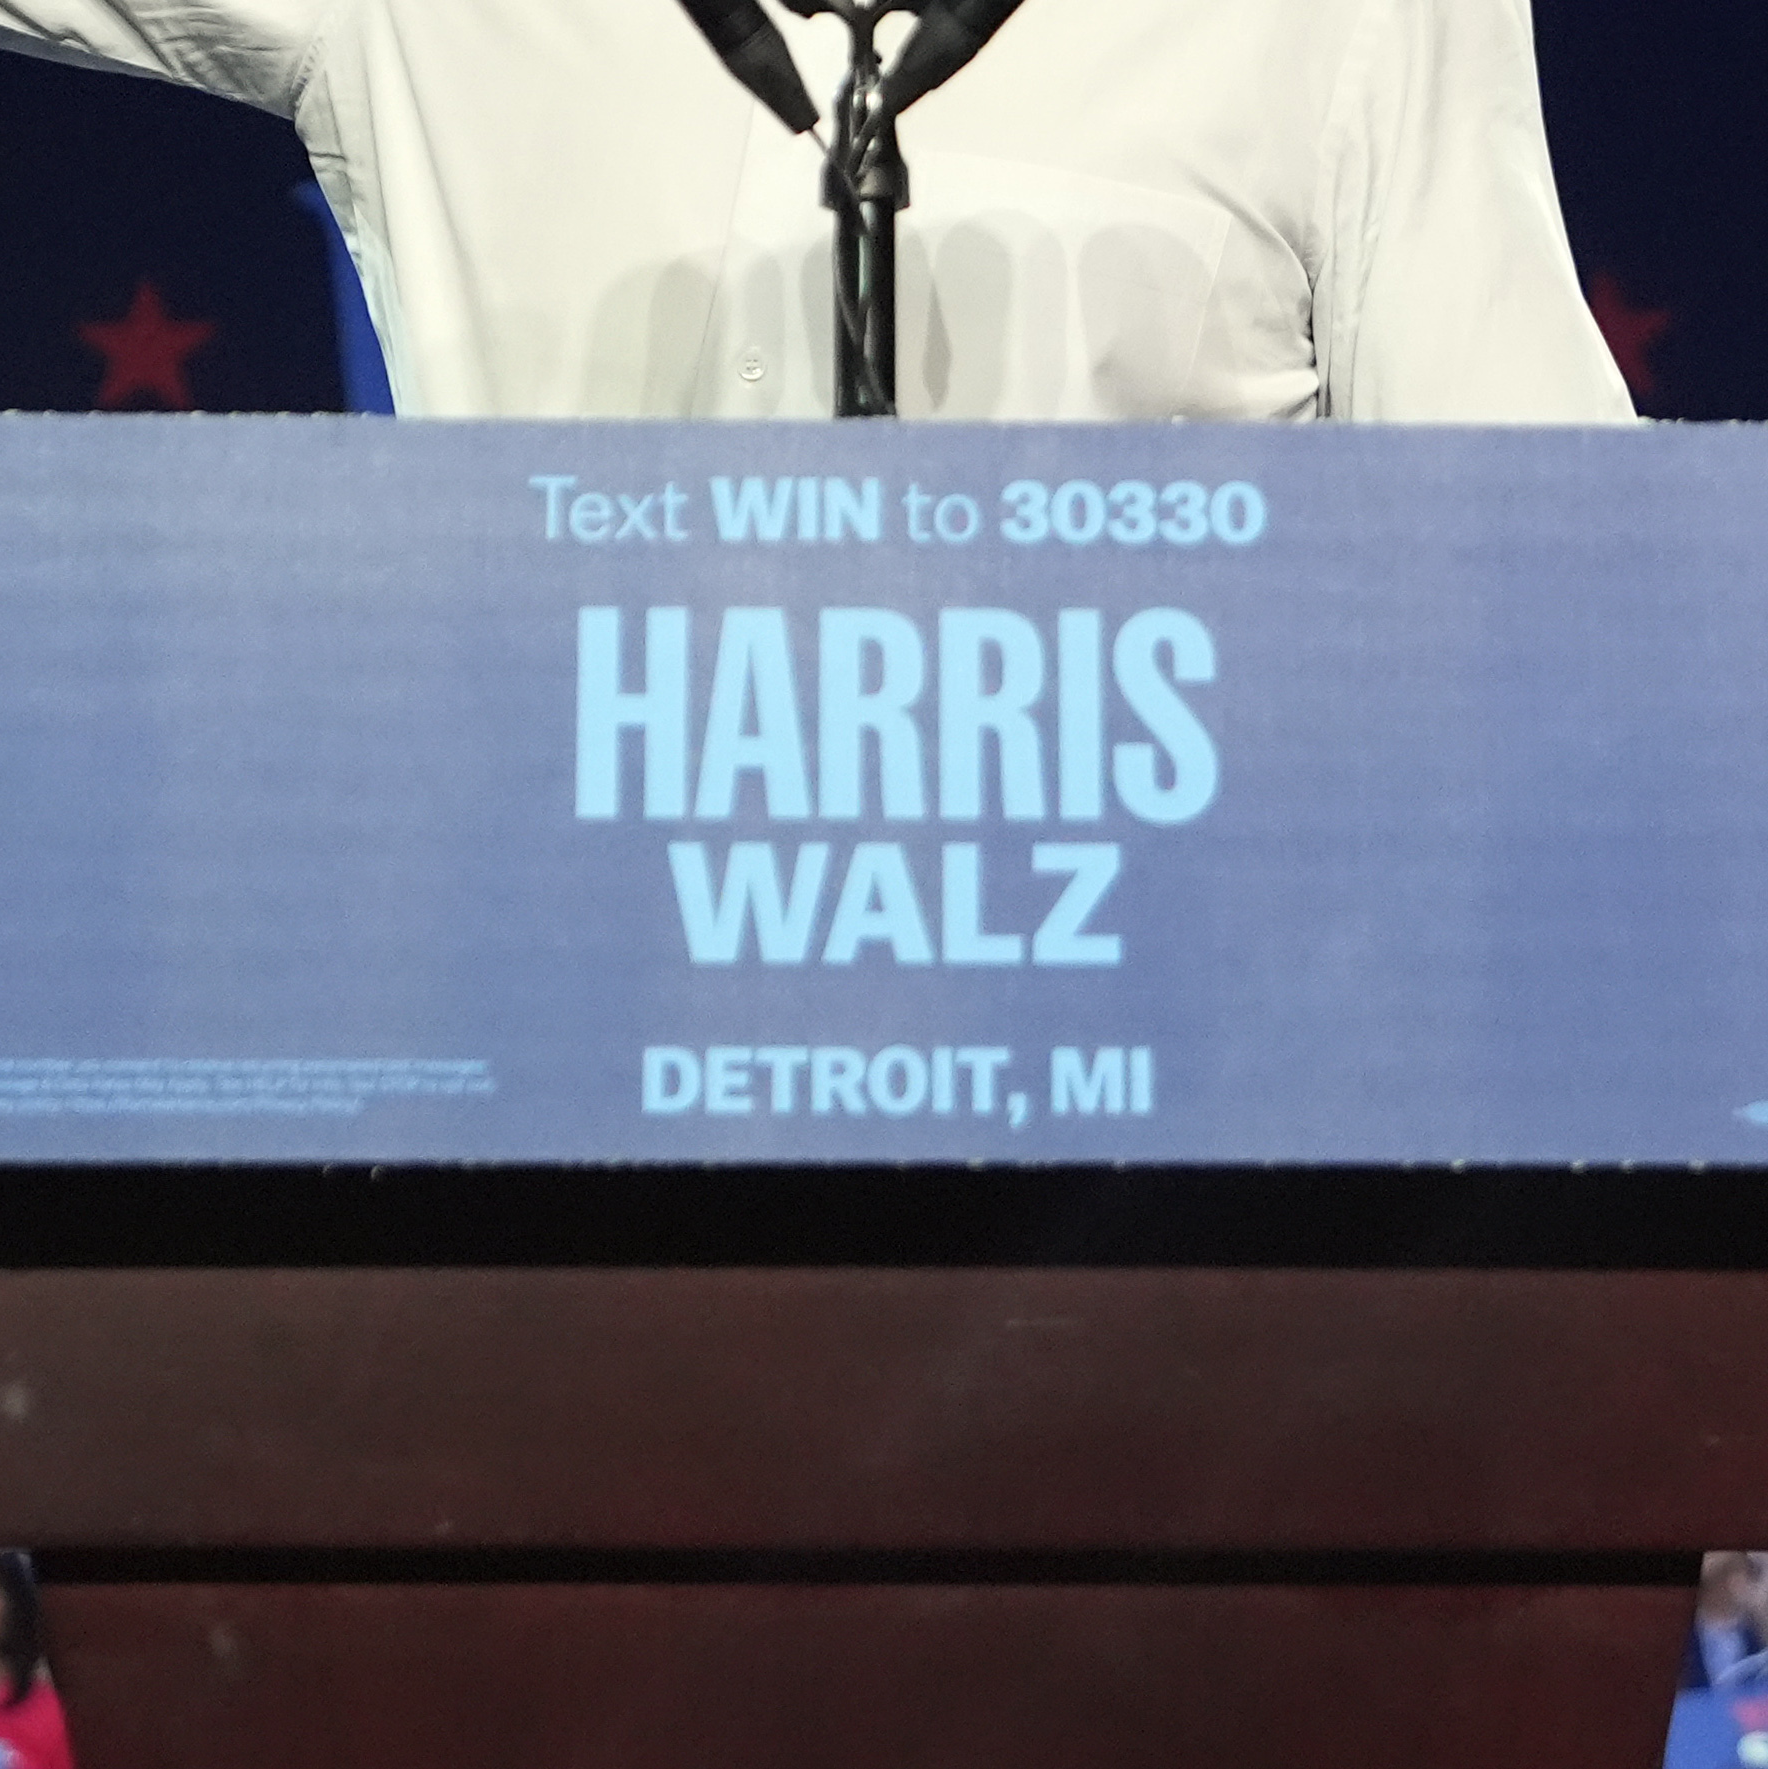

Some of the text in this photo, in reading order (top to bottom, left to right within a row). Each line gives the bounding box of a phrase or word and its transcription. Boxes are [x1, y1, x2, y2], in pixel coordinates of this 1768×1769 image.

[529, 474, 1267, 544] Text WIN to 30330
[575, 606, 1218, 822] HARRIS
[668, 841, 1123, 965] WALZ
[641, 1044, 1153, 1128] DETROIT, MI
